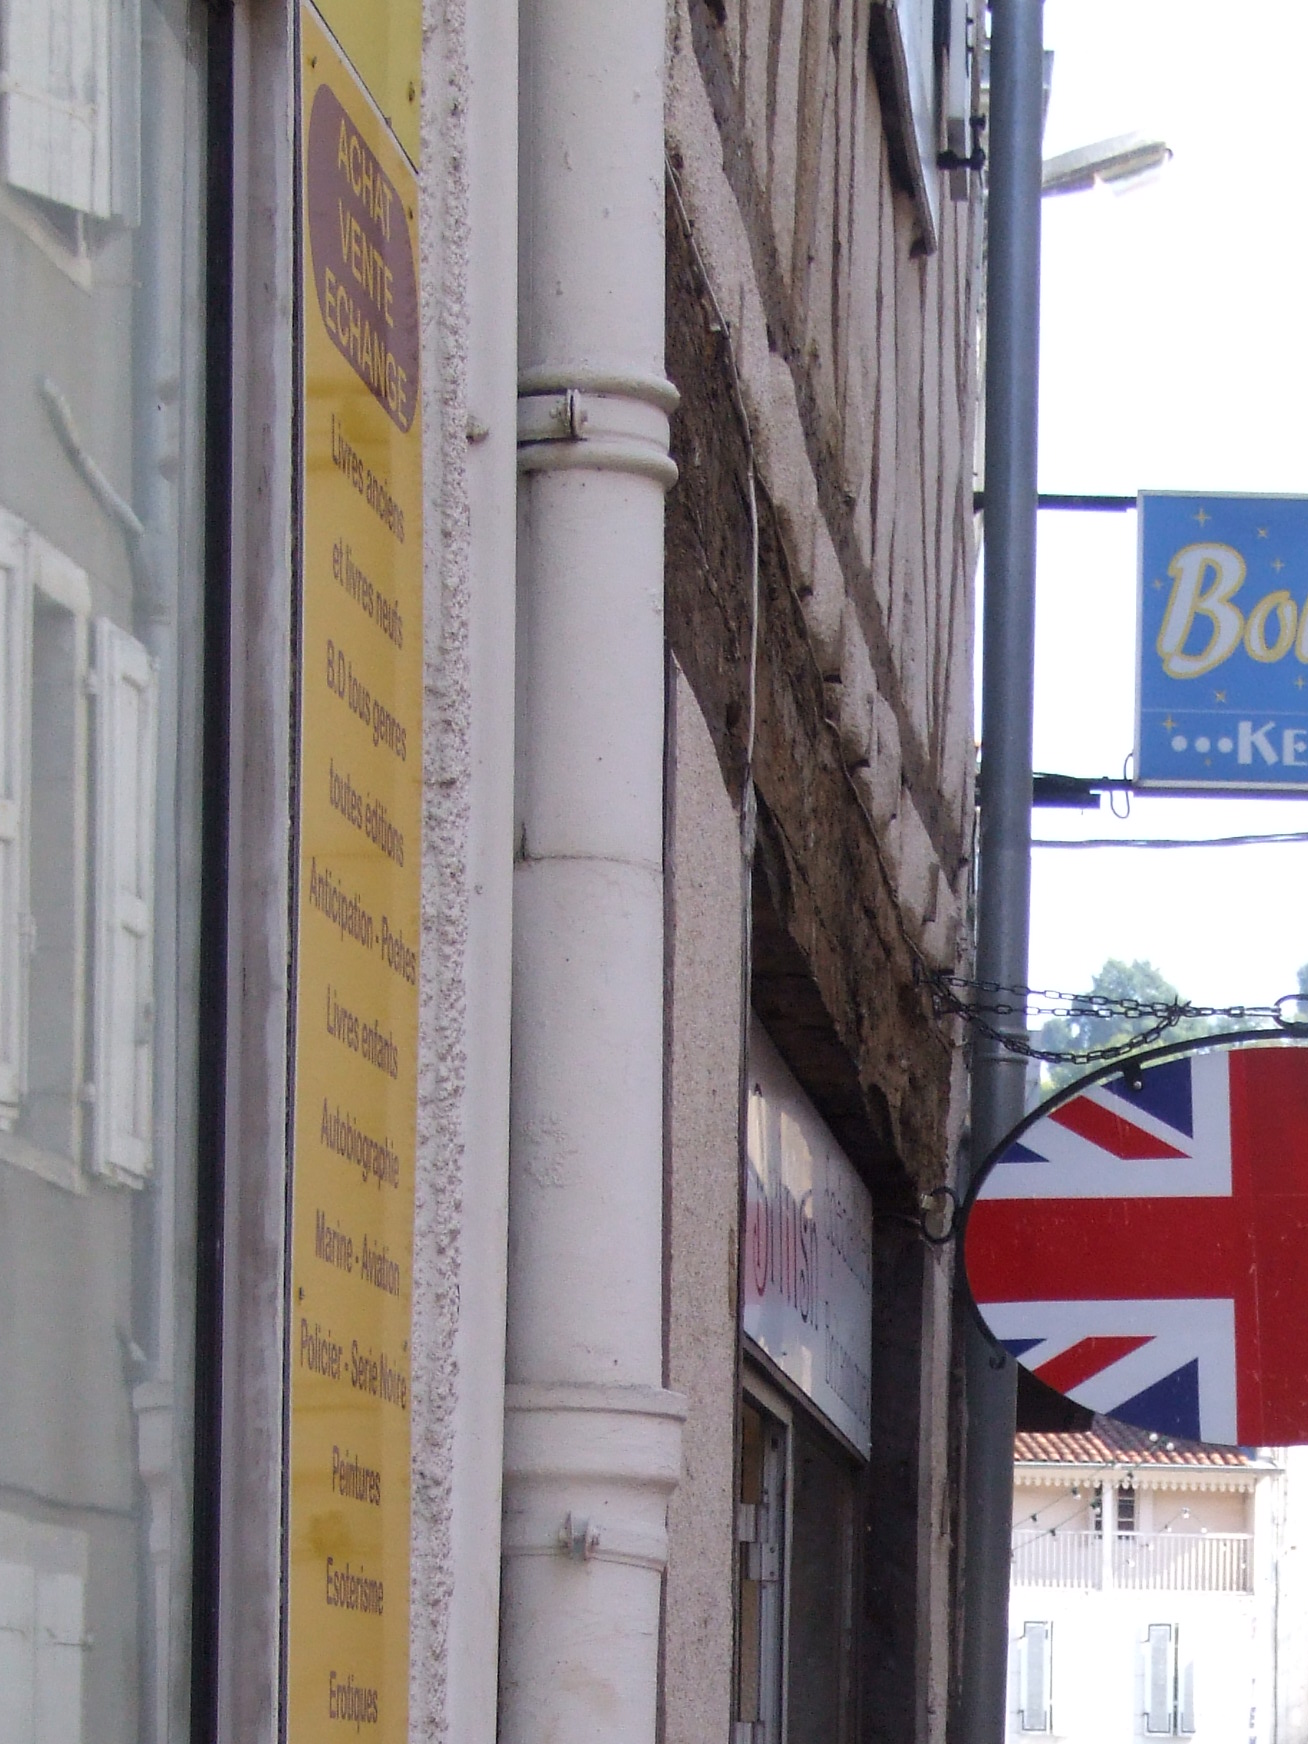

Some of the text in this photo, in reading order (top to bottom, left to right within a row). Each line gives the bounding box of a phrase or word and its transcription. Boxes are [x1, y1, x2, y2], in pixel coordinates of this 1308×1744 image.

[338, 117, 393, 243] ACHAT
[338, 198, 394, 328] VENTE
[325, 267, 407, 427] ECHANGE
[332, 412, 405, 543] Livres anciens
[332, 537, 404, 650] et livres neufs
[348, 660, 371, 728] tous
[373, 697, 407, 762] genres
[329, 757, 363, 831] toutes
[309, 856, 374, 949] Anticipation
[381, 915, 417, 986] Poches
[327, 984, 399, 1080] Livres enfants
[320, 1096, 400, 1190] Autobiographie
[315, 1208, 353, 1274] Marine
[361, 1233, 400, 1296] Aviation
[300, 1317, 343, 1381] Policier
[379, 1352, 407, 1410] Noire
[332, 1444, 381, 1507] Peintures
[329, 1670, 378, 1734] Erotiques
